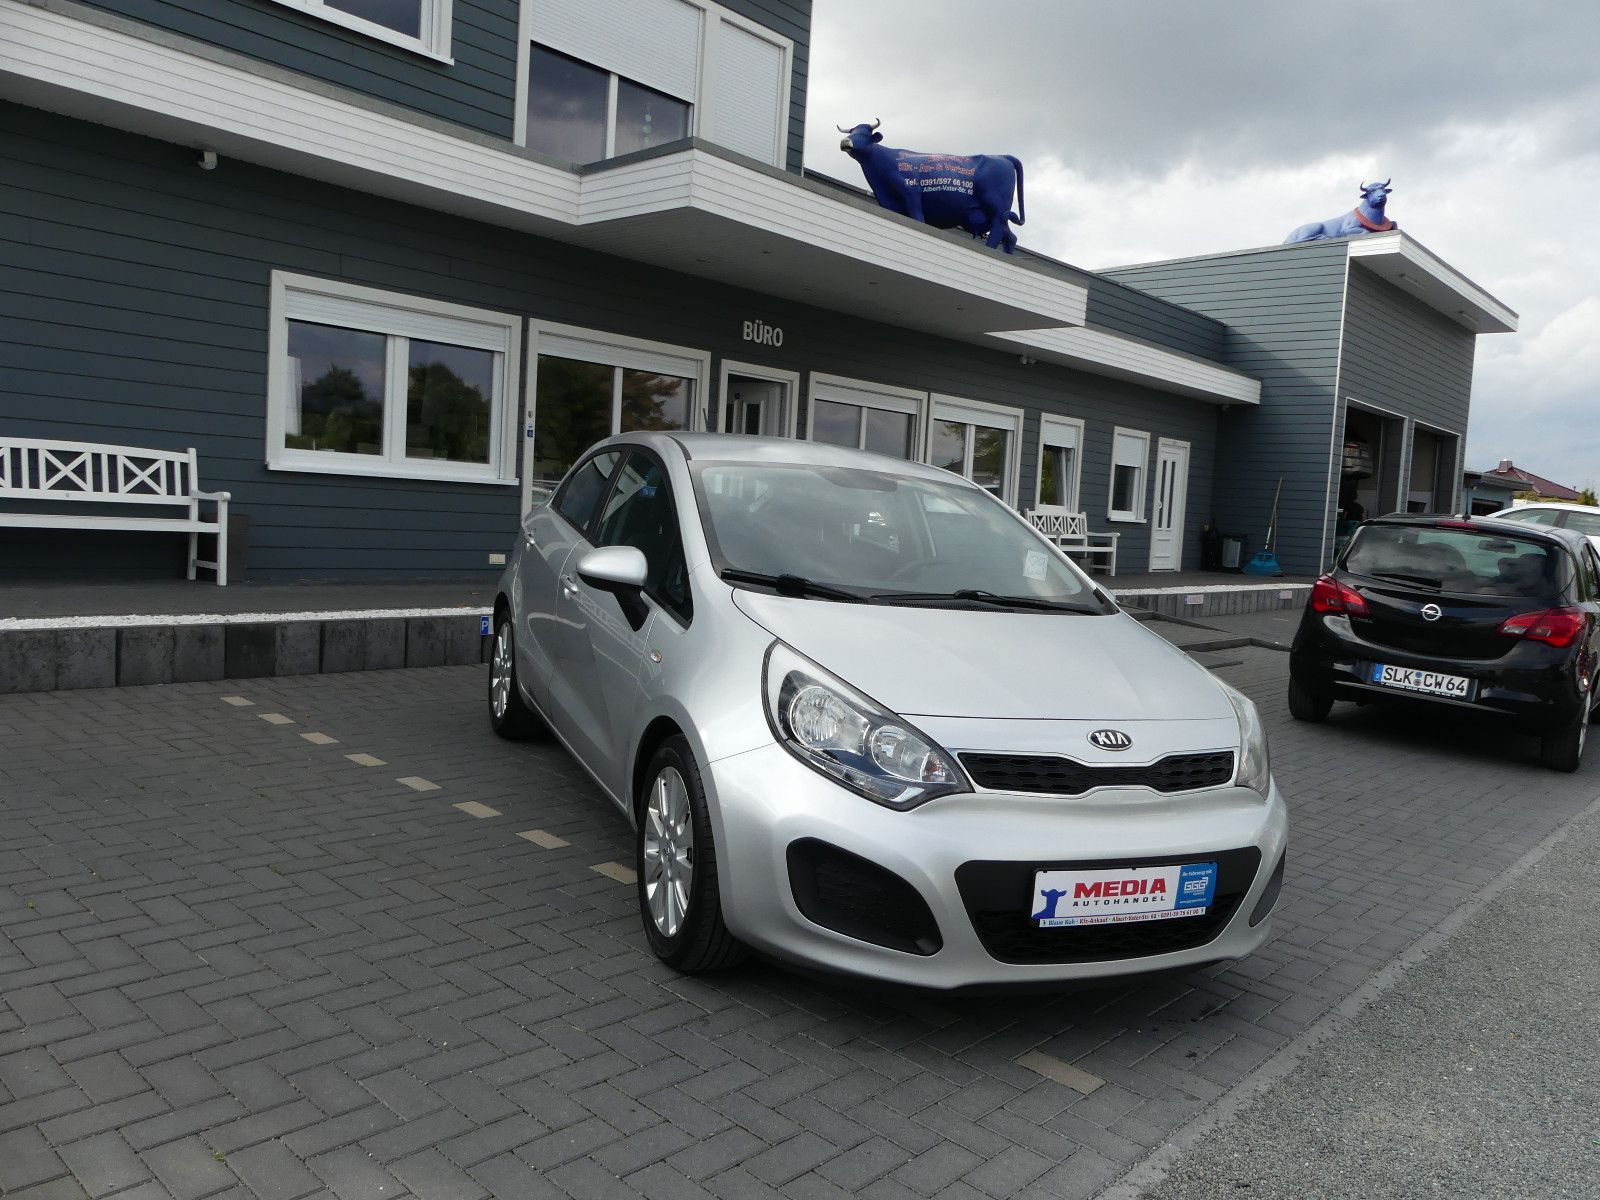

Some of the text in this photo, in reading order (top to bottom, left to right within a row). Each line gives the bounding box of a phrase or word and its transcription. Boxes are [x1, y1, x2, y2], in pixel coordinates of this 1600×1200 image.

[743, 319, 783, 347] BÜRO
[1383, 667, 1414, 684] SLK
[1423, 674, 1444, 689] CW
[1446, 678, 1465, 693] 64
[1094, 731, 1129, 745] KIA
[1074, 878, 1166, 898] MEDIA
[1073, 895, 1166, 907] AUTOHANDEL
